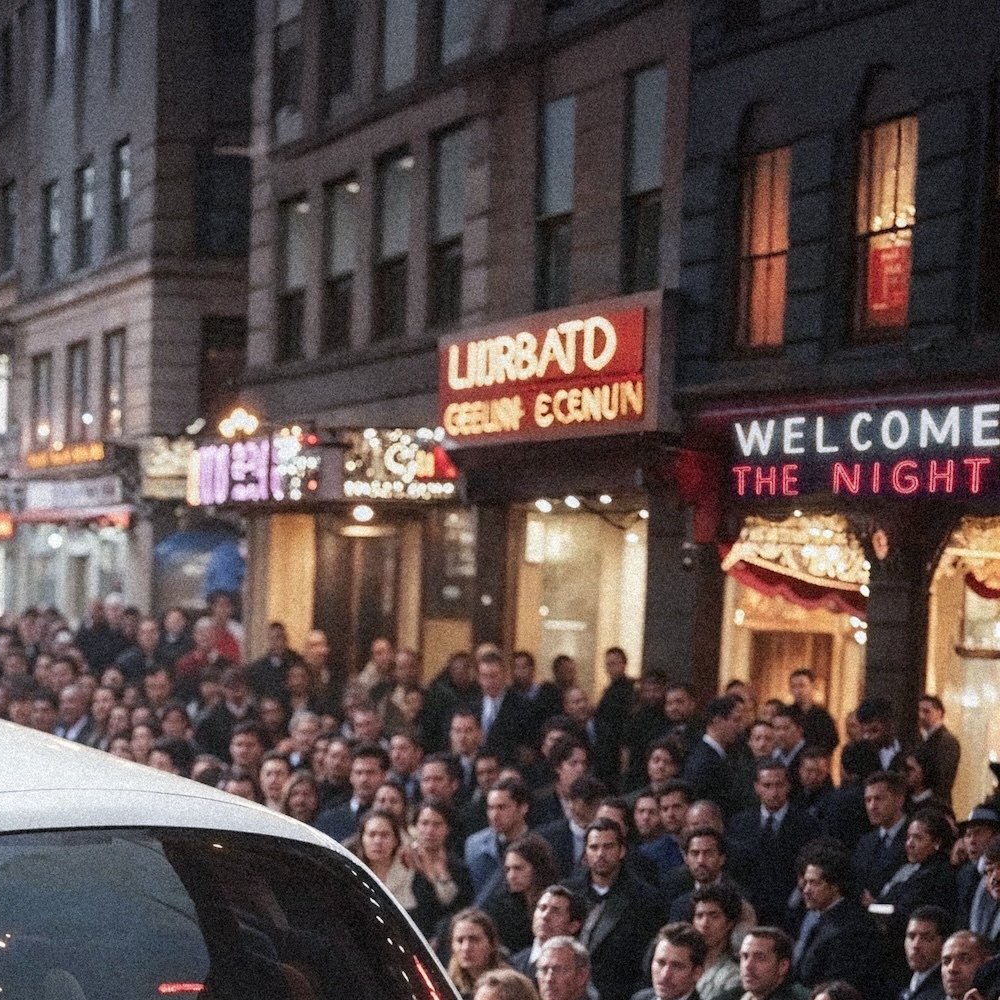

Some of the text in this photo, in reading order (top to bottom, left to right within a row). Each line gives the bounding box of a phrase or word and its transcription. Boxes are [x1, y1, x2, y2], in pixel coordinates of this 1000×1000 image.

[734, 403, 1000, 456] WELCOME
[732, 457, 991, 496] THE NIGHT
